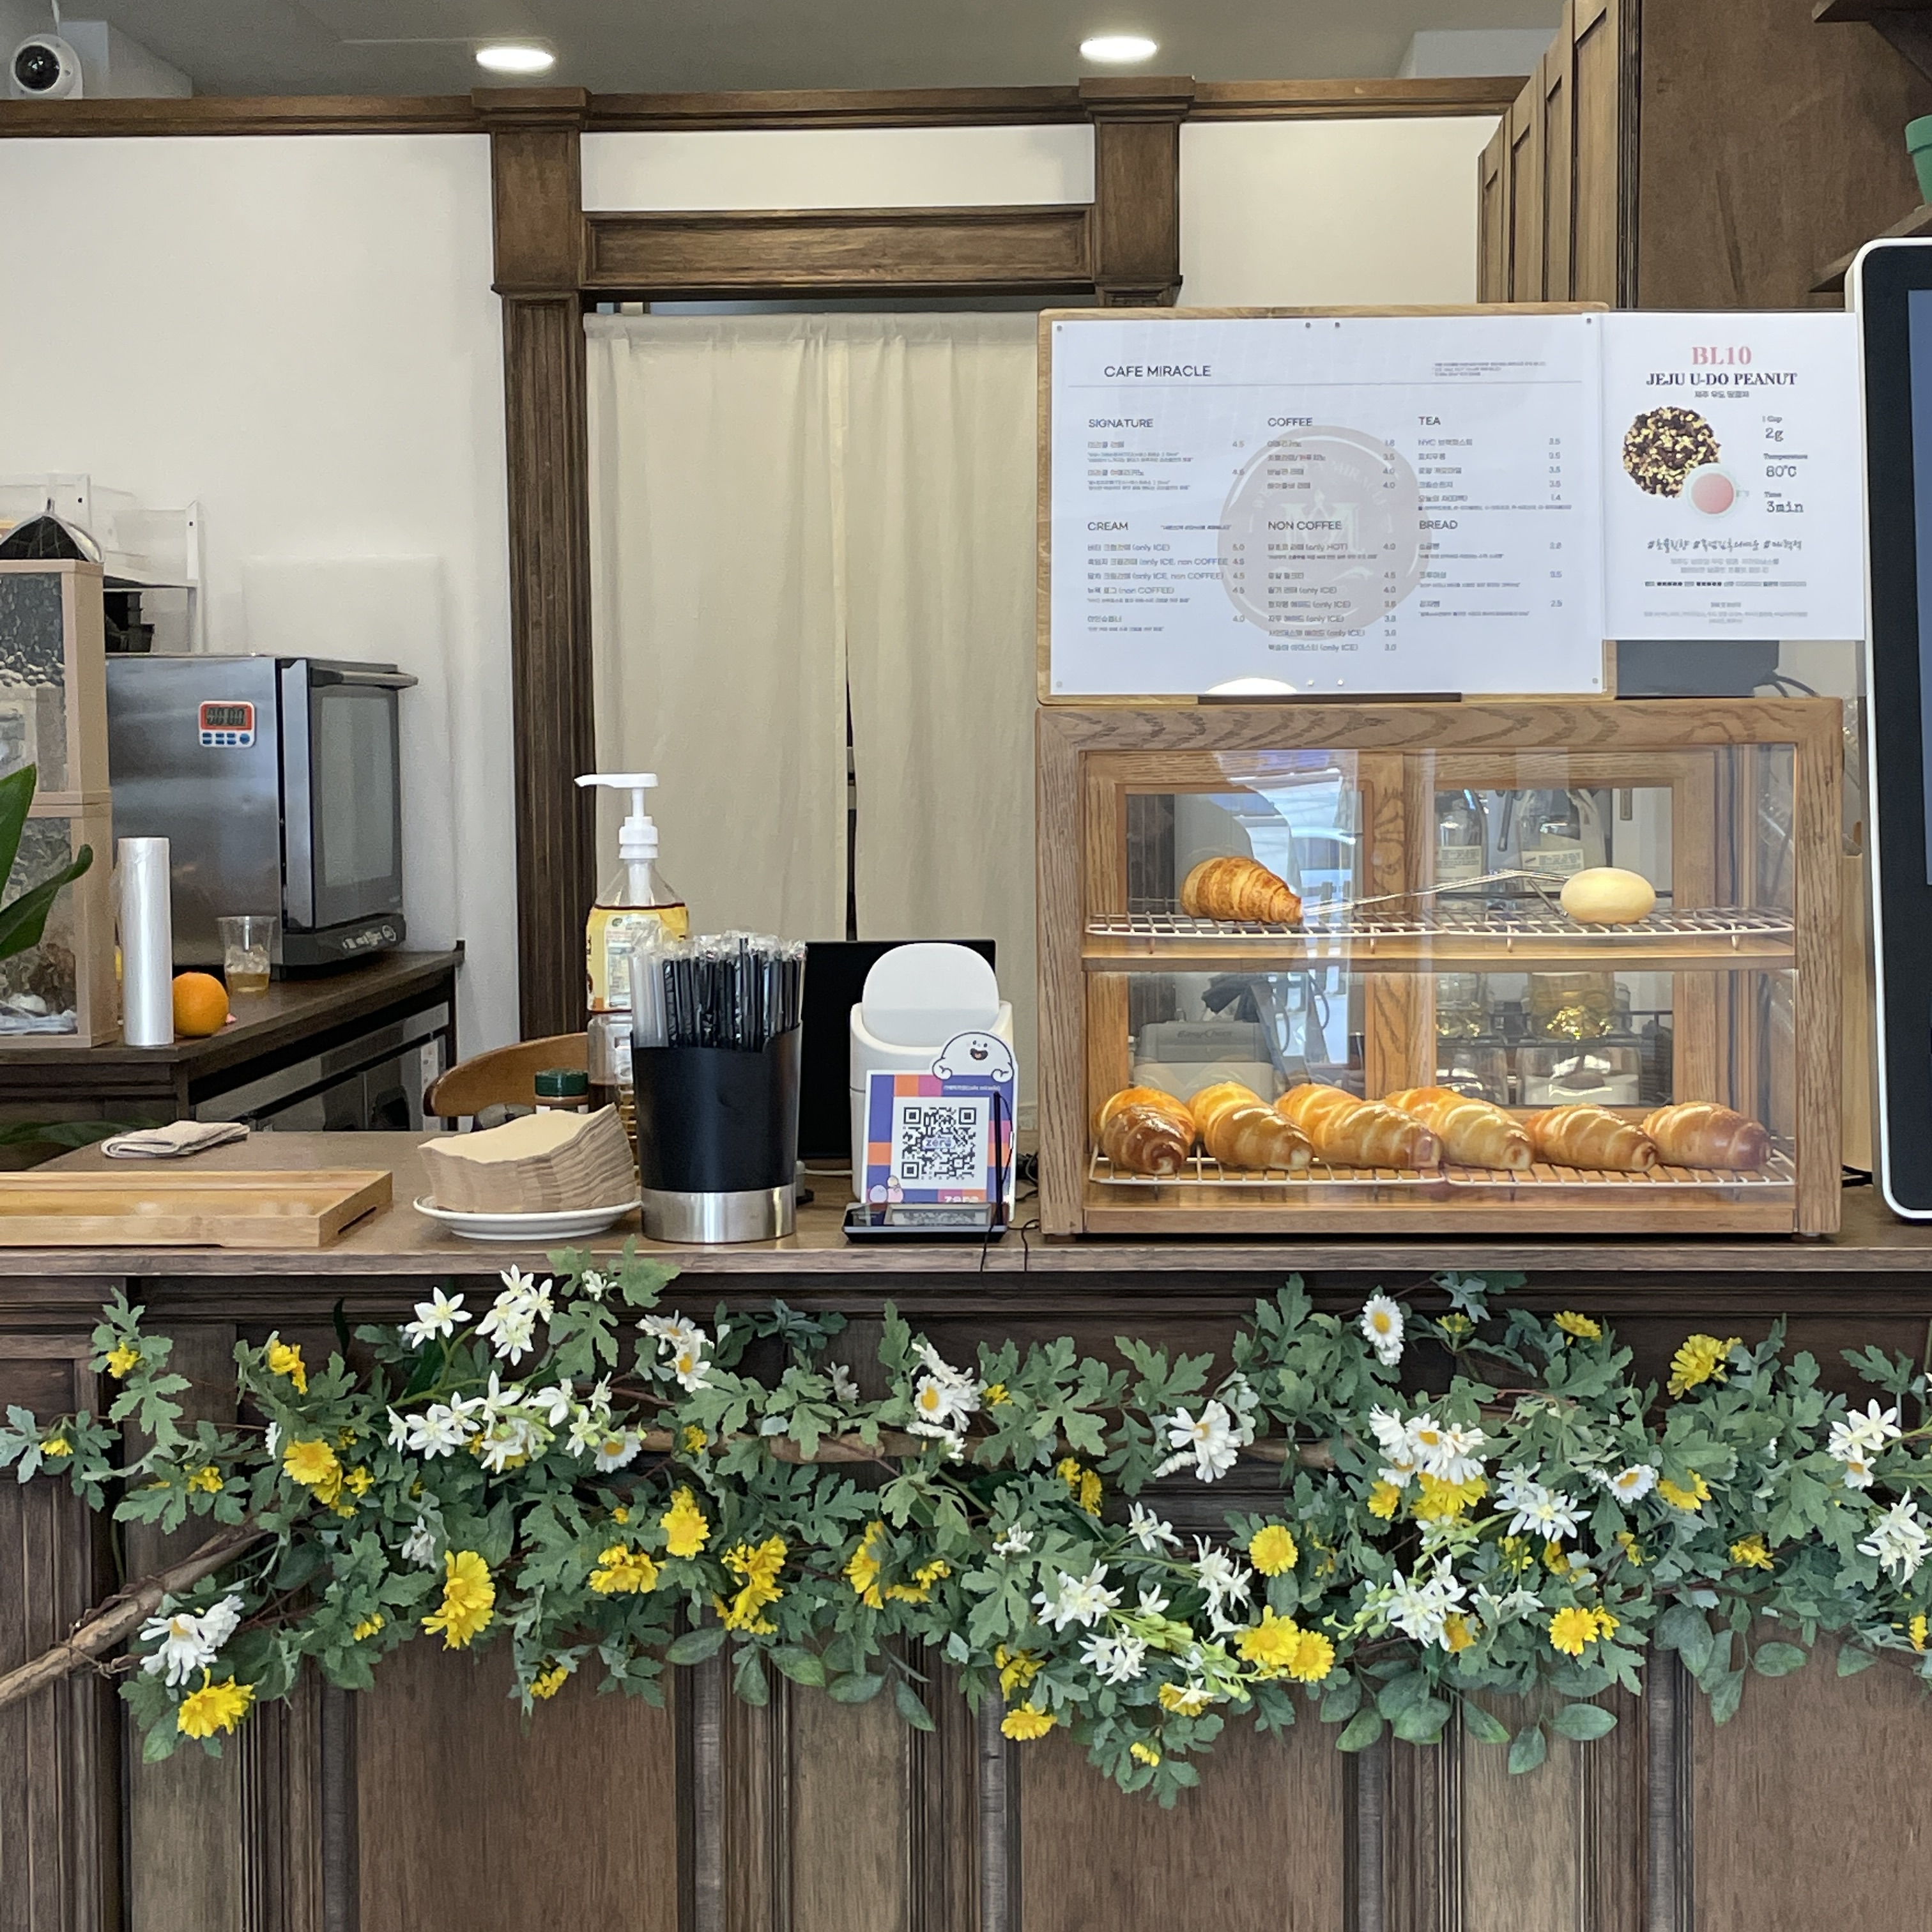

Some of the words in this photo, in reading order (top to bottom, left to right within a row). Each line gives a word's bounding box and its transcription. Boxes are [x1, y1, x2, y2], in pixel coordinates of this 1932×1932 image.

[1692, 346, 1752, 365] BL10
[1104, 365, 1143, 378] CAFE
[1147, 365, 1211, 377] MIRACLE
[1646, 372, 1685, 386] JEJU
[1690, 372, 1729, 386] U-DO
[1733, 372, 1798, 385] PEANUT
[1088, 418, 1154, 428] SIGNATURE
[1268, 417, 1313, 427] COFFEE
[1418, 417, 1441, 425] TEA
[1765, 427, 1784, 441] 2g
[1767, 501, 1804, 512] 3min
[1087, 522, 1128, 530] CREAM
[1268, 521, 1294, 530] NON
[1296, 521, 1342, 530] COFFEE
[1419, 521, 1458, 530] BREAD
